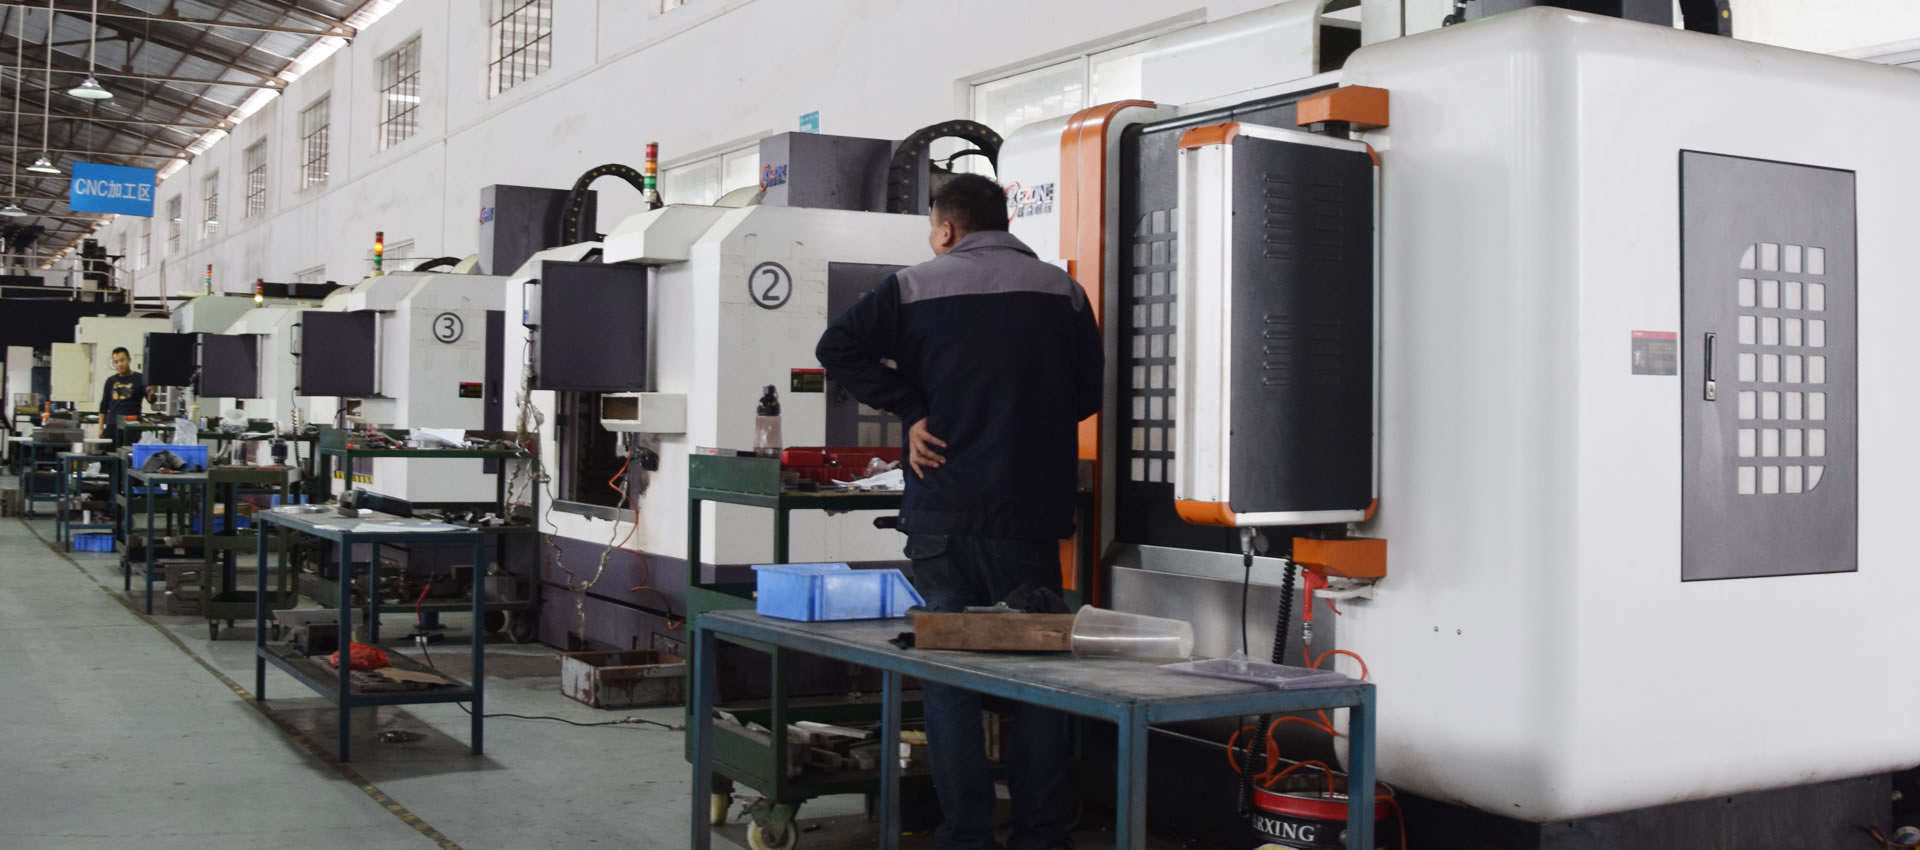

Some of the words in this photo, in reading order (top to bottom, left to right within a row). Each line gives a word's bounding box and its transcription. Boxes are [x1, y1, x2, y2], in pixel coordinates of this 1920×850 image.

[75, 178, 152, 202] CNC加工区
[762, 268, 780, 301] 2
[442, 317, 455, 338] 3
